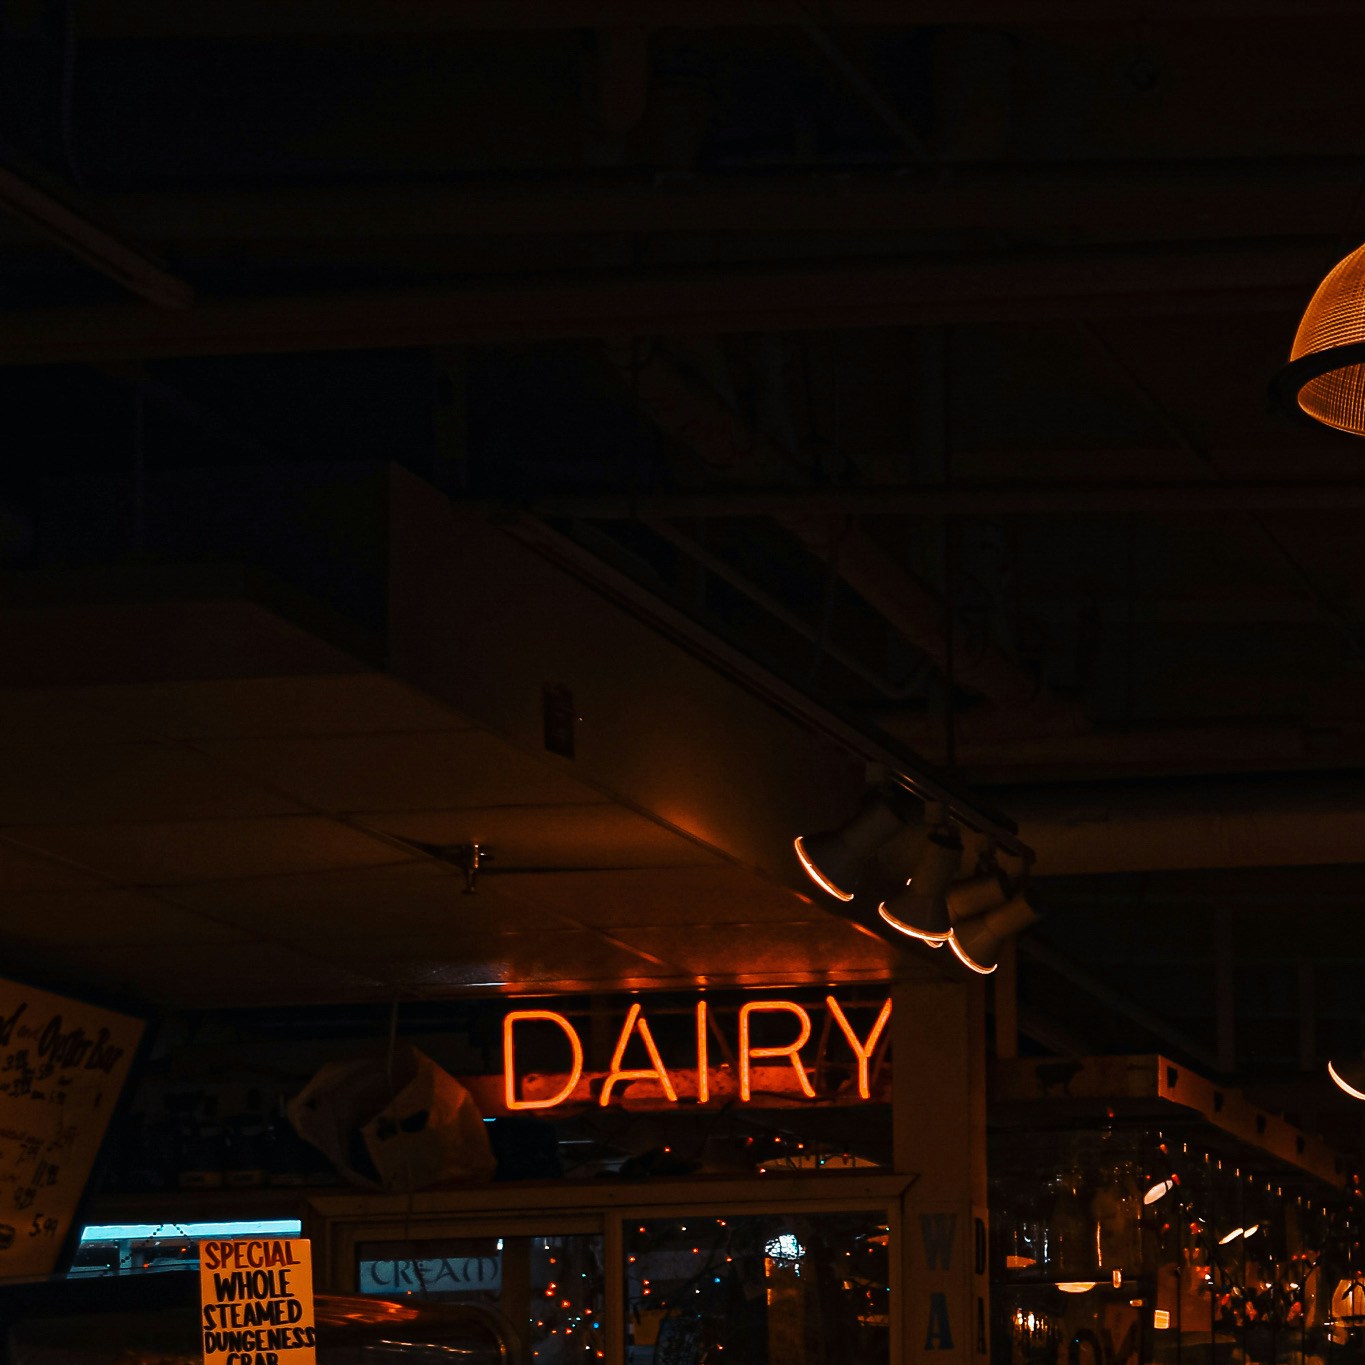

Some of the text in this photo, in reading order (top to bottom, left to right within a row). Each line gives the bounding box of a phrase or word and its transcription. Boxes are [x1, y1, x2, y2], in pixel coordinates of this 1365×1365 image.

[504, 995, 893, 1111] DAIRY
[204, 1241, 301, 1270] SPECIAL
[213, 1269, 295, 1302] WHOLE
[203, 1299, 303, 1330] STEAMED
[204, 1326, 318, 1354] DUNGENESS
